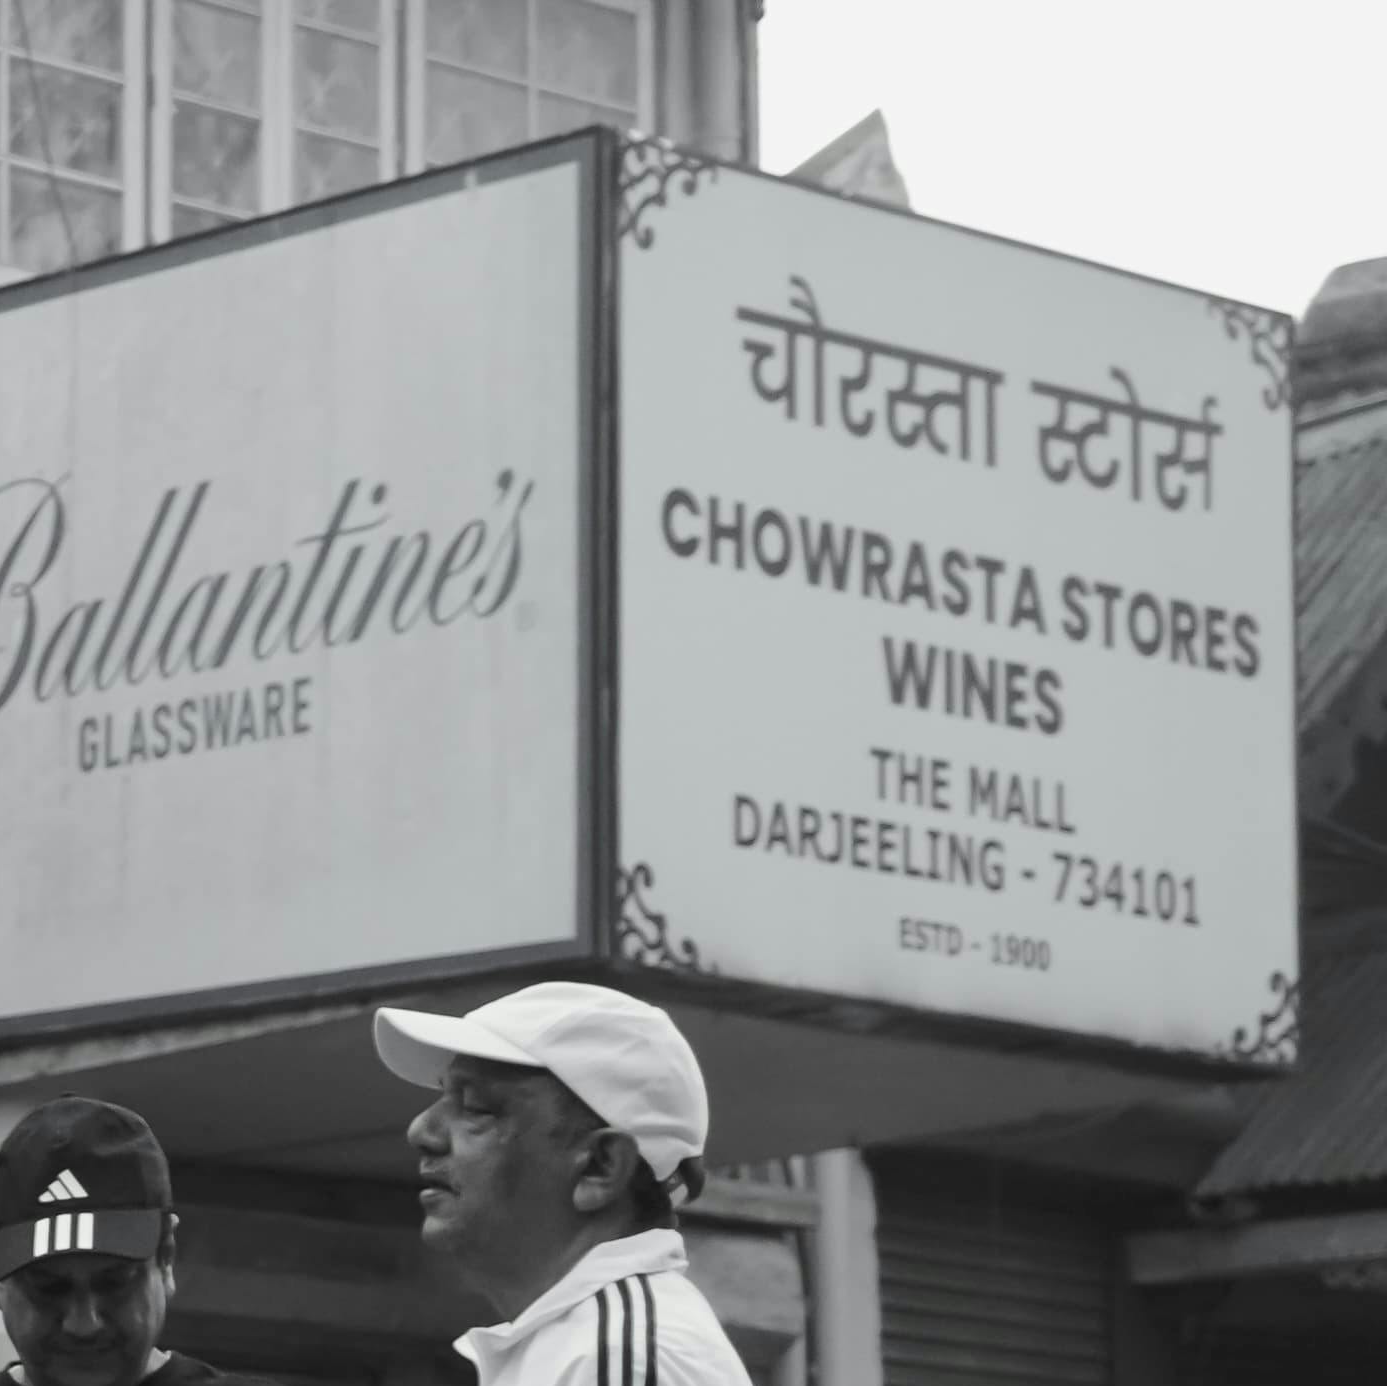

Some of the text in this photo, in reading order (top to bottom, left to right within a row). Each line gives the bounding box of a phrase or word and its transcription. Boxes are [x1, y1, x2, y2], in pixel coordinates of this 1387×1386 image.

[736, 275, 1224, 512] चौरस्ता स्टोर्स
[661, 487, 1261, 680] CHOWRASTA STORES
[77, 677, 313, 774] GLASSWARE
[882, 637, 1064, 736] WINES
[869, 746, 1077, 836] THE MALL
[734, 794, 1005, 892] DARJEELING
[1052, 852, 1201, 928] 734101
[898, 916, 965, 959] ESTD
[990, 932, 1053, 974] 1900
